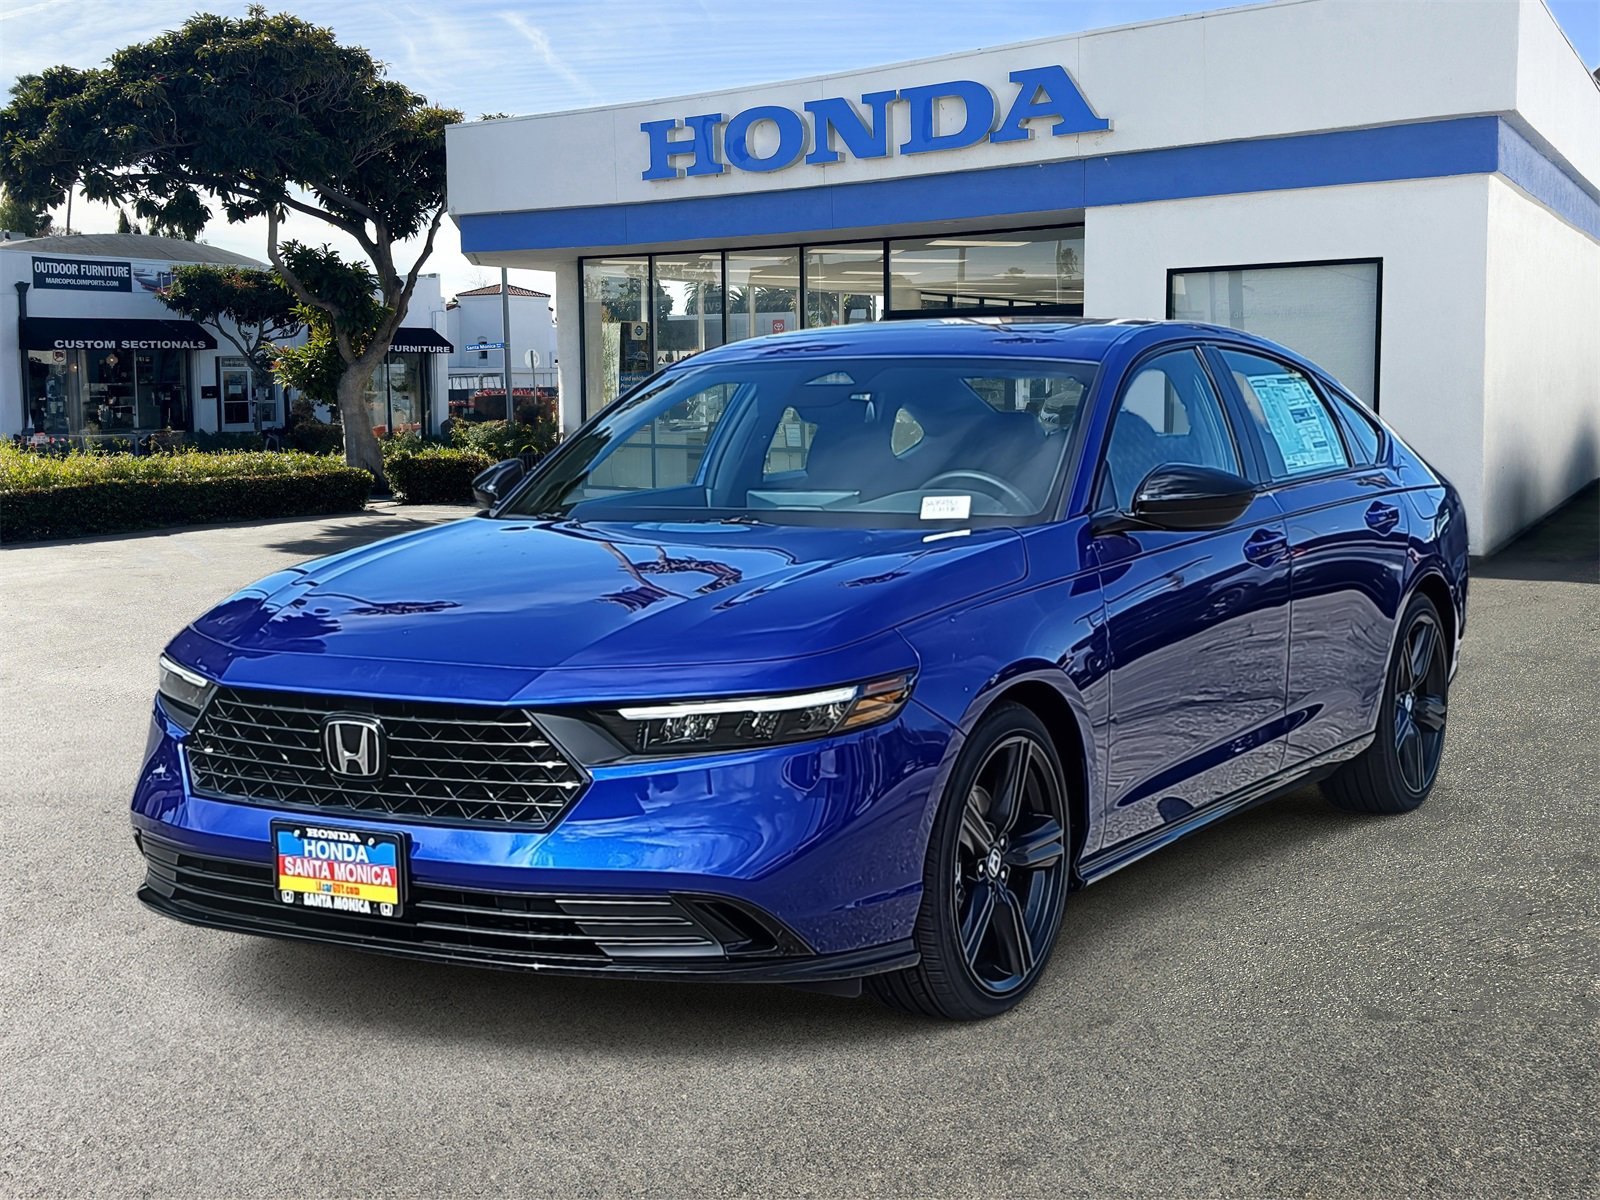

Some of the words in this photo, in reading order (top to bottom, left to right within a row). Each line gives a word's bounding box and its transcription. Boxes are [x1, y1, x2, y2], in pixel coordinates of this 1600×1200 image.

[640, 65, 1113, 181] HONDA
[34, 261, 78, 275] OUTDOOR
[80, 264, 130, 278] FURNITURE
[45, 277, 119, 287] MARCOPOLOIMPORTS.COM
[54, 339, 116, 349] CUSTOM
[121, 339, 206, 349] SECTIONALS
[388, 344, 450, 353] FURNITURE
[306, 828, 361, 842] HONDA
[303, 840, 369, 863] HONDA
[284, 857, 331, 880] SANTA
[333, 861, 393, 886] MONICA
[303, 892, 333, 909] SANTA
[333, 895, 372, 914] MONICA
